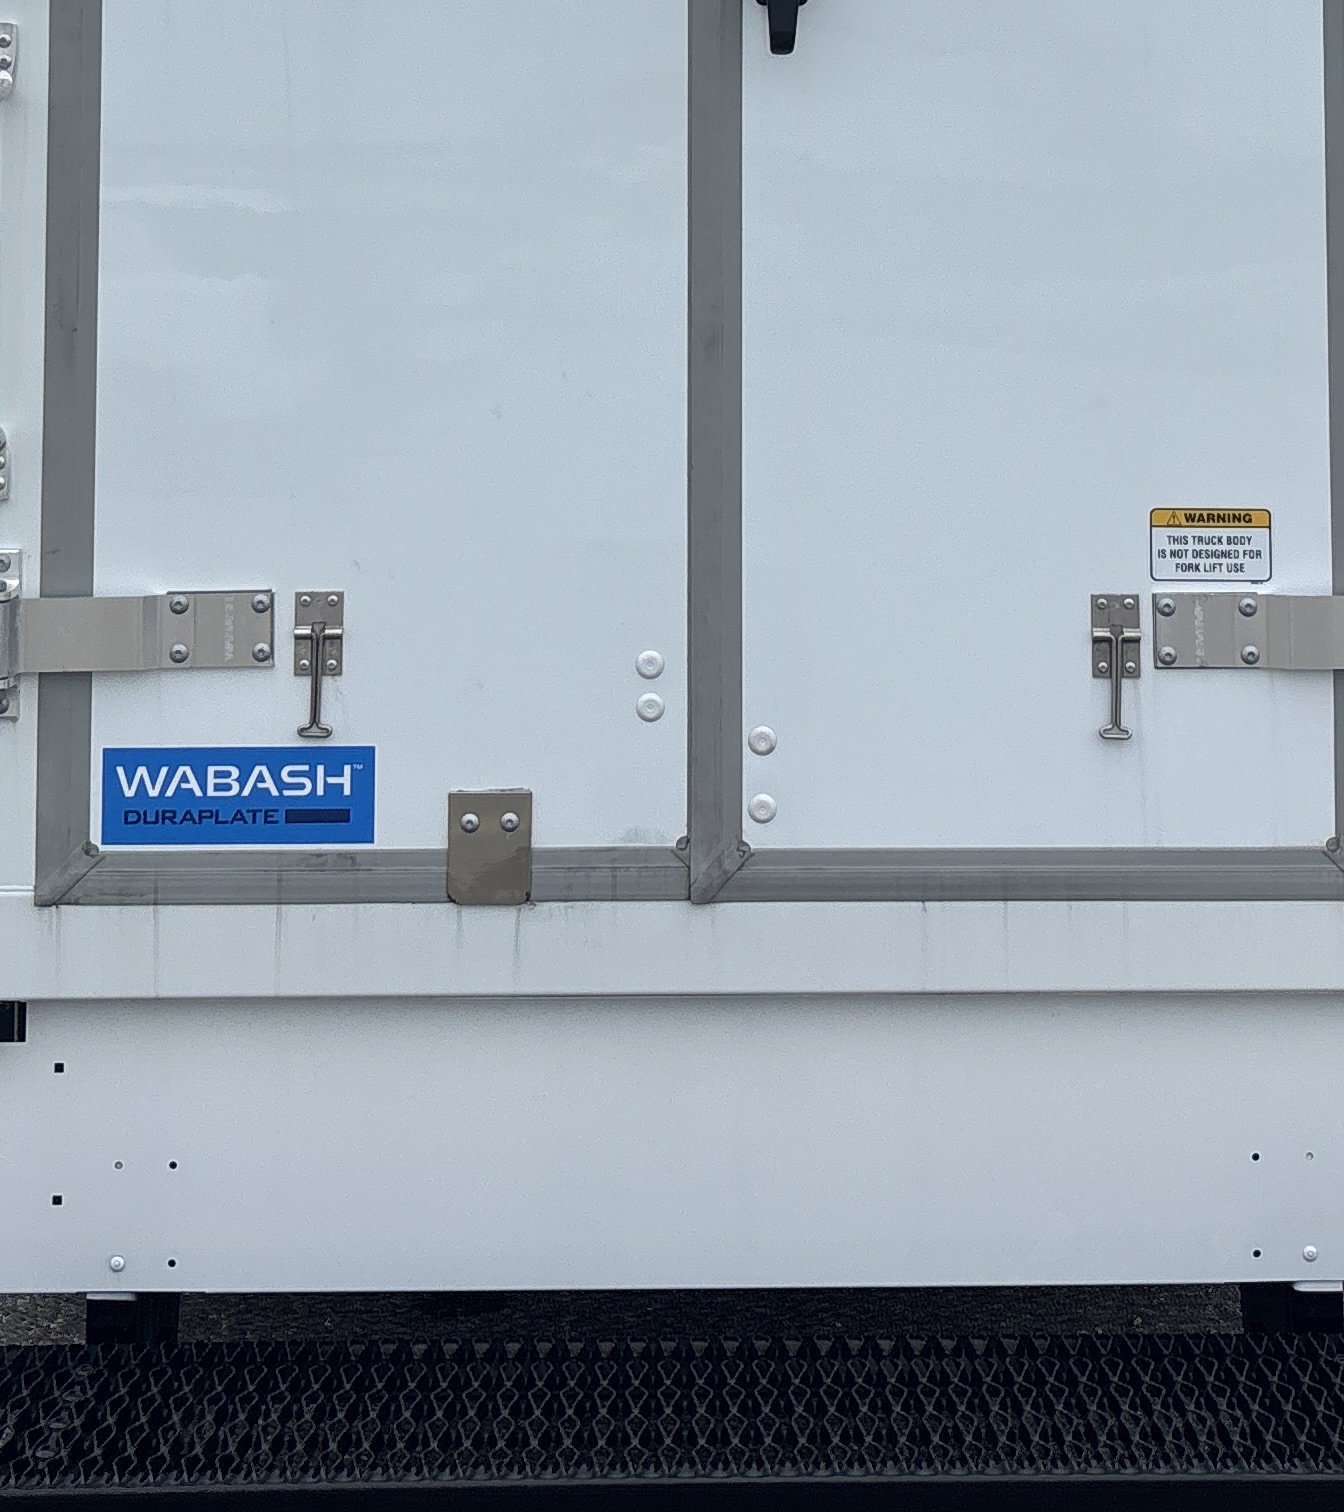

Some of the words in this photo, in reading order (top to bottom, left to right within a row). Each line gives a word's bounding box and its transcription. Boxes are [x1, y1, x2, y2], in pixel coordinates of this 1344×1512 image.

[1183, 513, 1253, 524] WARNING
[1166, 535, 1189, 546] THIS
[1191, 535, 1224, 546] TRUCK
[1226, 535, 1253, 546] BODY
[1157, 548, 1167, 559] IS
[1169, 548, 1189, 560] NOT
[1191, 549, 1240, 560] DESIGNED
[1242, 549, 1263, 560] FOR
[1175, 562, 1202, 573] FORK
[1203, 562, 1224, 573] LIFT
[1226, 562, 1246, 574] USE
[115, 764, 351, 798] WABASH
[123, 808, 280, 825] DURAPLATE
